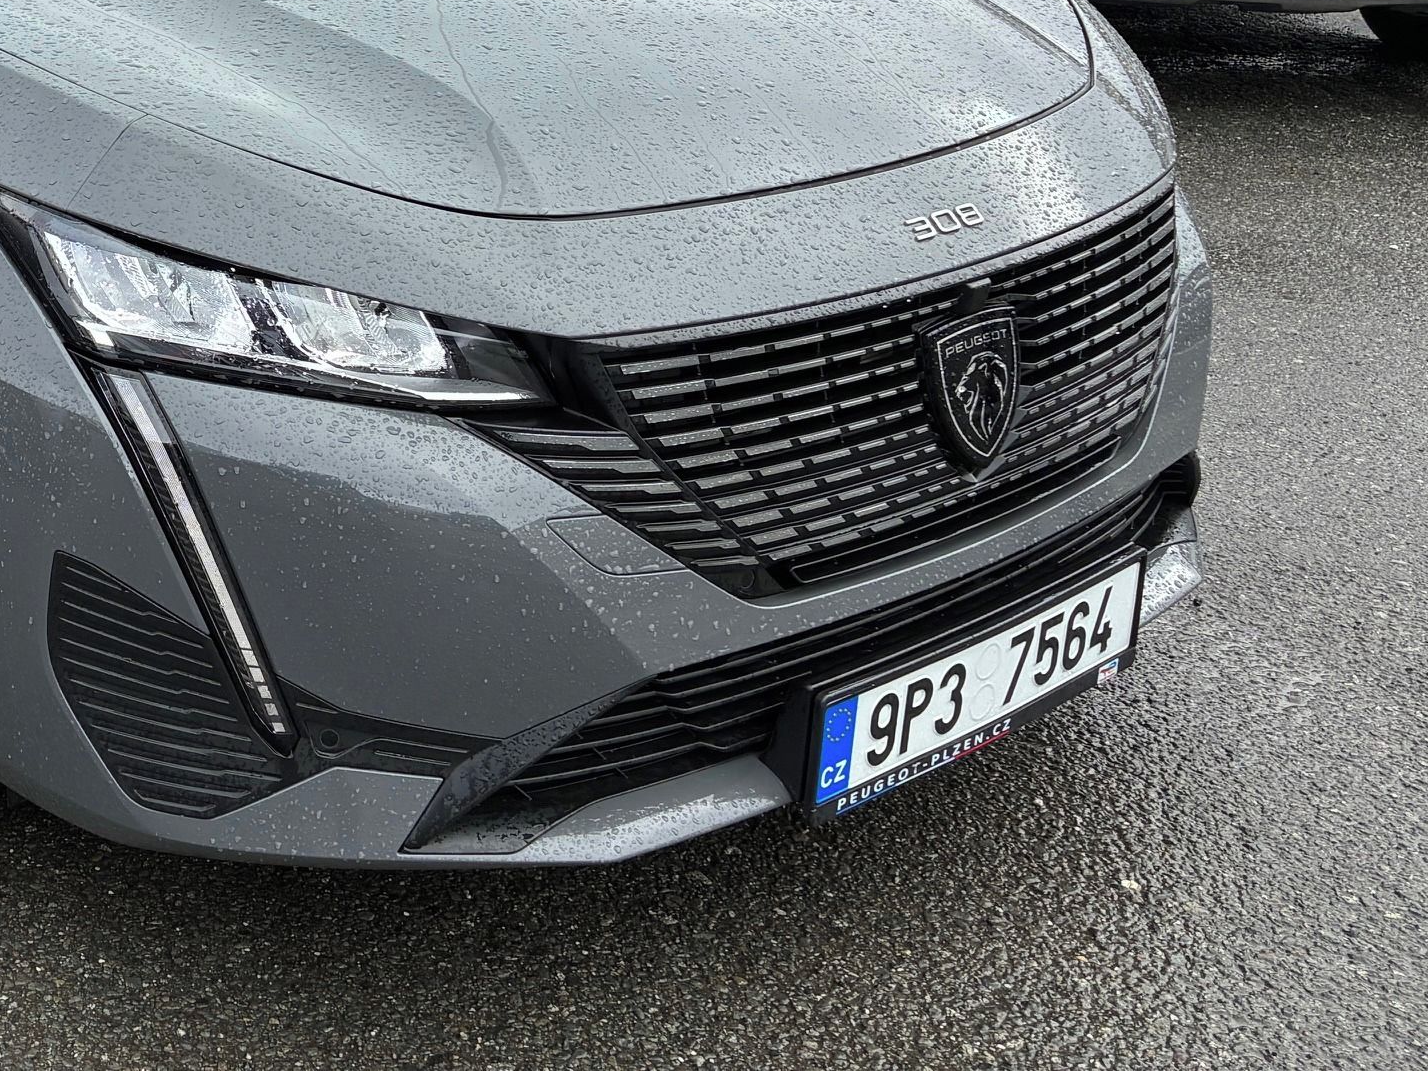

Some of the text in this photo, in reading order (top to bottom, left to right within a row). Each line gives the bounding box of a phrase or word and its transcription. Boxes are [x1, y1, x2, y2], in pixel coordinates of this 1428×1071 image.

[905, 203, 985, 241] 308
[945, 328, 1009, 359] PEUGEOT
[866, 586, 1114, 767] 9P3 7564
[820, 759, 848, 789] CZ
[836, 717, 1012, 811] PEUGEOT-PLZEN.CZ
